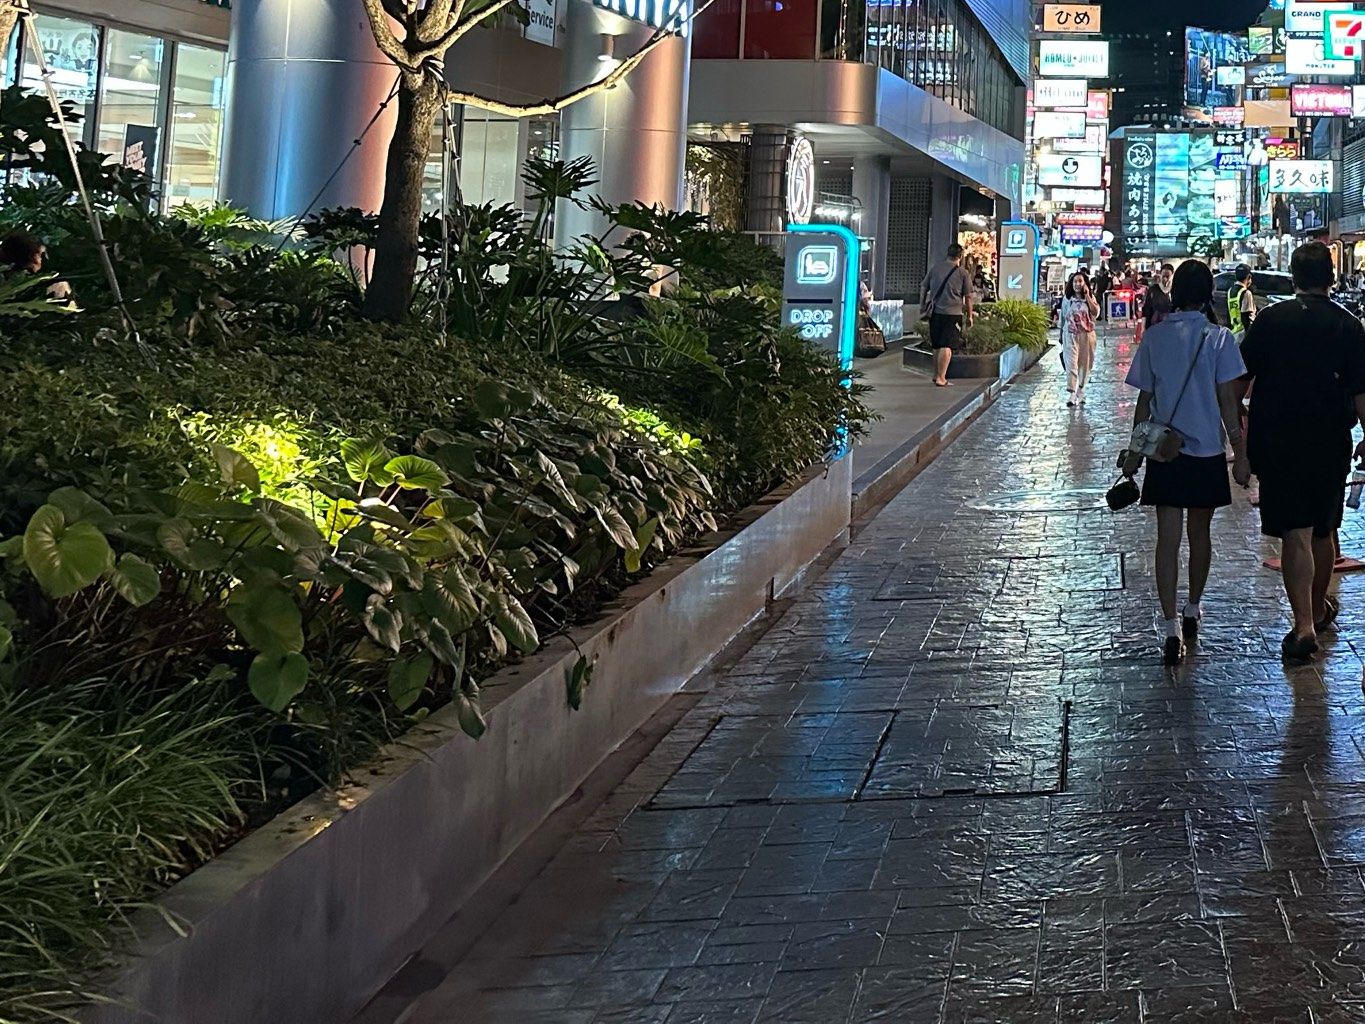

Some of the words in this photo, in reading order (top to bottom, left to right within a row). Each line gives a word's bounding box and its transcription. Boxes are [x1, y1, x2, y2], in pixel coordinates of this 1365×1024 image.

[528, 6, 554, 30] ervice
[1055, 10, 1091, 26] ひめ
[790, 309, 834, 324] DROP
[801, 324, 833, 338] OFF
